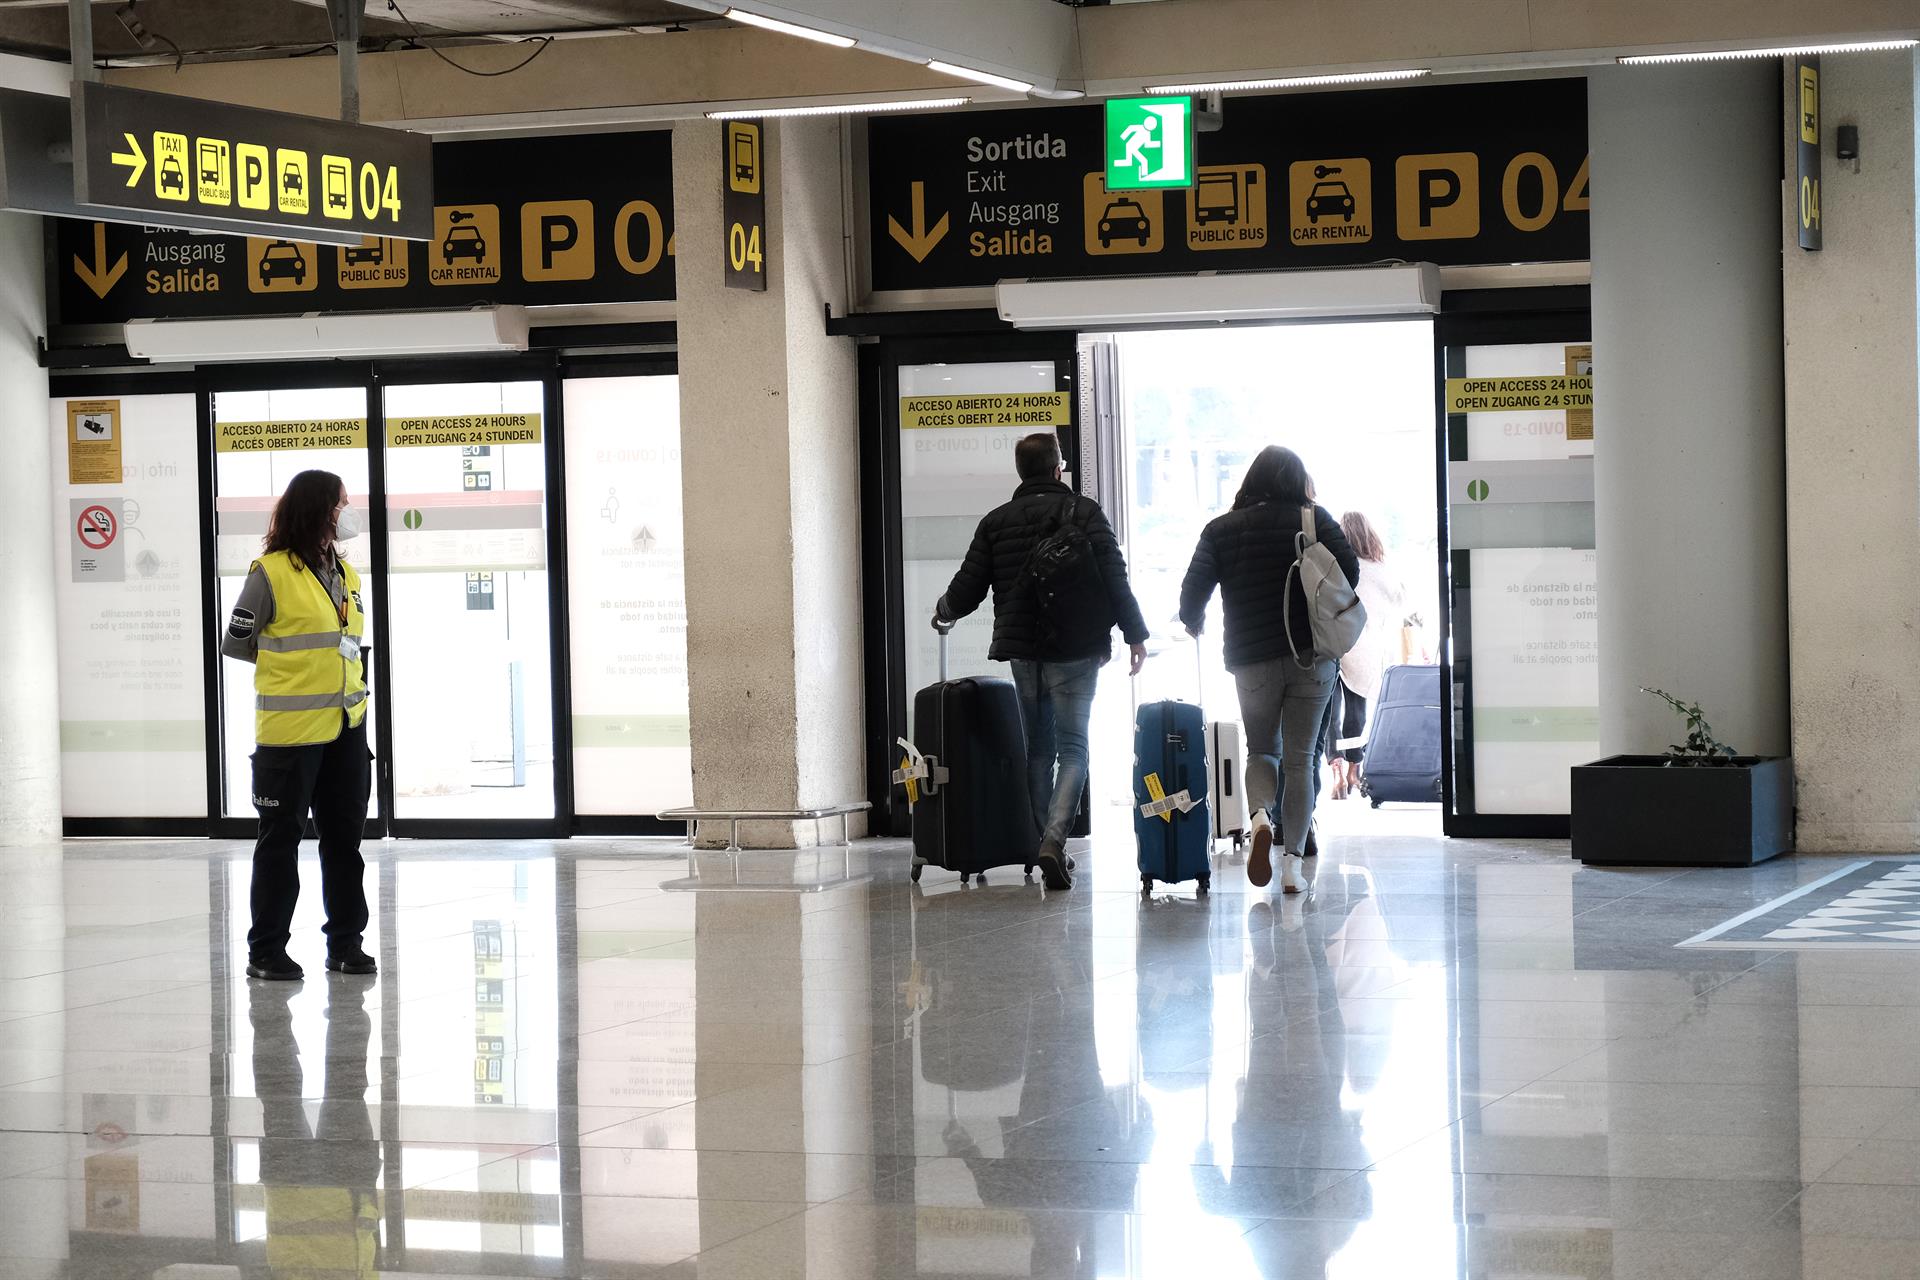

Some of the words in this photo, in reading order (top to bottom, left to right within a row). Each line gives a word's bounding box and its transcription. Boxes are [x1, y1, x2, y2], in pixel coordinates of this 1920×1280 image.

[160, 136, 182, 153] TAXI
[967, 133, 1067, 163] Sortida
[246, 155, 262, 199] P
[967, 170, 1006, 193] Exit
[199, 187, 218, 198] PUBLIC
[219, 189, 230, 200] BUS
[360, 162, 401, 222] 04
[1418, 168, 1461, 228] P
[279, 197, 289, 207] CAR
[289, 197, 308, 209] RENTAL
[1802, 176, 1820, 230] 04
[969, 200, 1060, 226] Ausgang
[614, 200, 675, 275] 0
[1191, 228, 1235, 242] PUBLIC
[1239, 227, 1265, 241] BUS
[1293, 227, 1318, 240] CAR
[1322, 224, 1370, 239] RENTAL
[541, 215, 579, 270] P
[730, 222, 763, 273] 04
[970, 228, 1052, 257] Salida
[145, 242, 226, 263] Ausgang
[146, 269, 220, 294] Salida
[341, 269, 380, 282] PUBLIC
[384, 267, 406, 281] BUS
[431, 268, 453, 281] CAR
[456, 266, 499, 280] RENTAL
[1463, 382, 1496, 393] OPEN
[1499, 380, 1547, 392] ACCESS
[1551, 379, 1566, 390] 24
[1569, 378, 1593, 390] HOU
[908, 400, 953, 412] ACCESO
[956, 398, 1003, 410] ABIERTO
[1006, 397, 1020, 408] 24
[1023, 396, 1061, 408] HORAS
[1455, 397, 1490, 409] OPEN
[1492, 395, 1540, 408] ZUGANG
[1544, 395, 1559, 406] 24
[1563, 394, 1593, 406] STUN
[401, 418, 429, 431] OPEN
[431, 417, 472, 430] ACCESS
[475, 416, 489, 429] 24
[491, 416, 526, 428] HOURS
[918, 413, 955, 426] ACCÉS
[958, 413, 994, 425] OBERT
[998, 412, 1012, 423] 24
[1015, 411, 1052, 423] HORES
[222, 422, 263, 437] ACCESO
[265, 421, 308, 435] ABIERTO
[310, 421, 324, 434] 24
[325, 420, 360, 432] HORAS
[231, 436, 264, 450] ACCÉS
[267, 436, 300, 449] OBERT
[302, 436, 316, 447] 24
[318, 435, 352, 447] HORES
[394, 433, 423, 446] OPEN
[425, 432, 468, 445] ZUGANG
[469, 431, 484, 443] 24
[486, 430, 534, 442] STUNDEN
